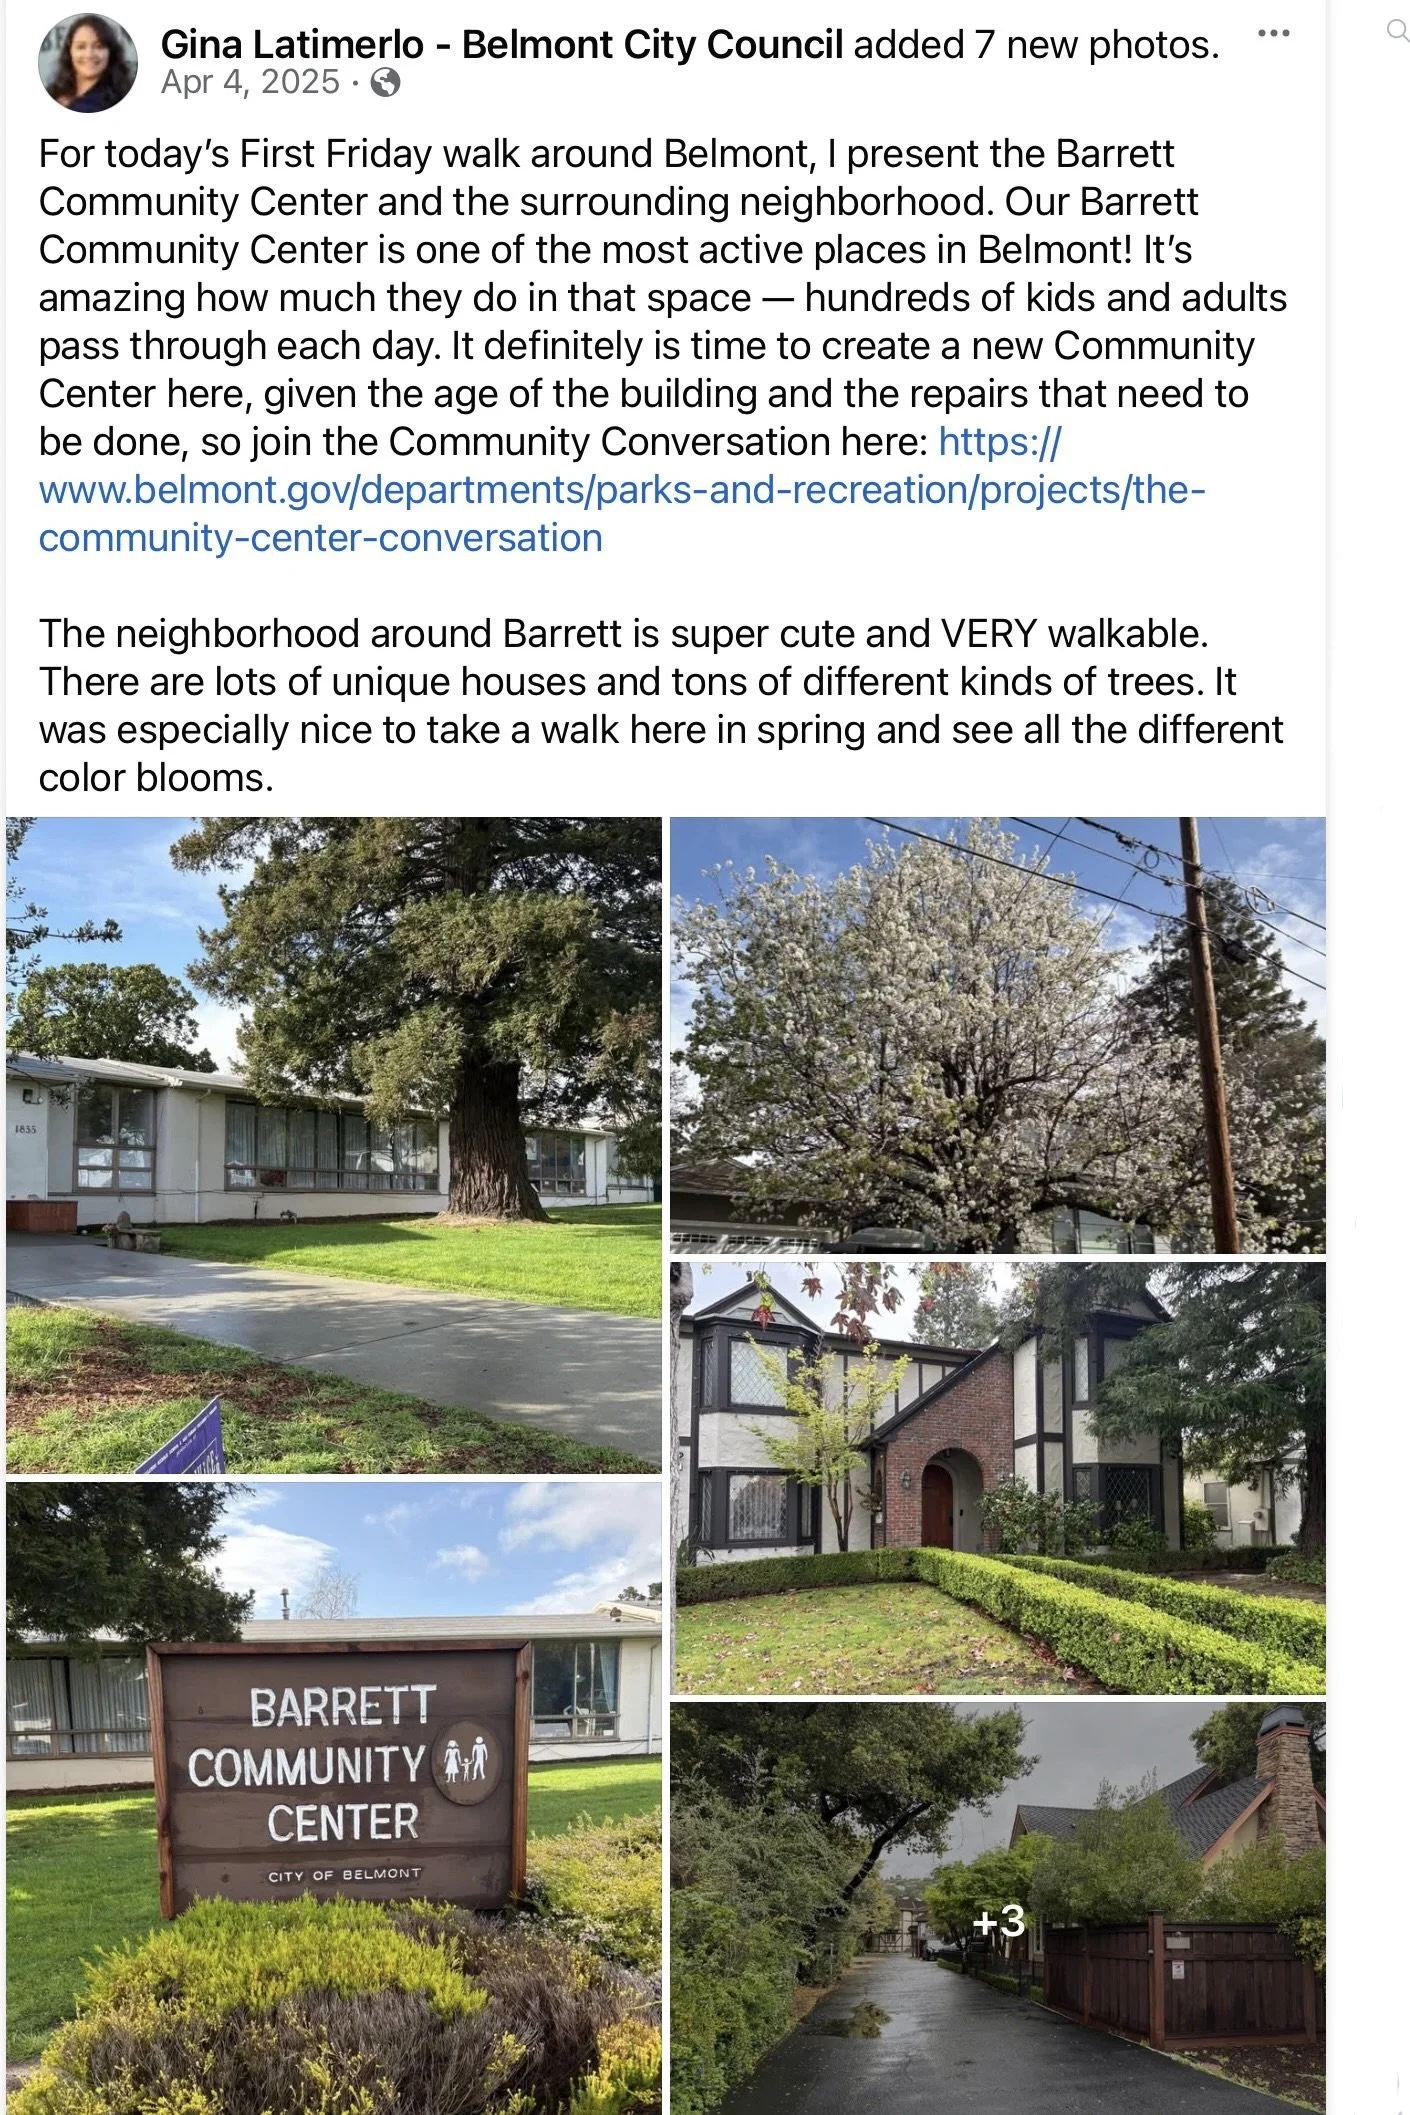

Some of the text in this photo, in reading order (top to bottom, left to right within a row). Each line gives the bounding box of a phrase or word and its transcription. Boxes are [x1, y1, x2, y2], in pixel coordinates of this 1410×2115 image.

[161, 27, 242, 60] Gina
[254, 27, 424, 60] Latimerlo
[463, 27, 614, 60] Belmont
[624, 27, 697, 67] City
[707, 27, 843, 60] Council
[854, 28, 964, 60] added
[975, 29, 996, 59] 7
[1008, 35, 1079, 60] new
[1090, 28, 1219, 66] photos.
[160, 67, 340, 100] Apr 4, 2025
[40, 138, 96, 169] For
[241, 137, 315, 169] First
[327, 137, 433, 175] Friday
[442, 137, 521, 169] walk
[531, 137, 652, 169] around
[665, 137, 817, 175] Belmont,
[829, 138, 835, 168] I
[848, 139, 979, 175] present
[989, 137, 1046, 169] the
[1057, 137, 1175, 169] Barrett
[39, 185, 1199, 224] Community Center and the surrounding neighborhood. Our Barrett
[39, 233, 240, 271] Community
[250, 233, 369, 265] Center
[378, 233, 406, 265] is
[416, 240, 481, 265] one
[491, 232, 526, 265] of
[535, 233, 592, 265] the
[603, 235, 689, 265] most
[699, 233, 804, 265] active
[815, 233, 927, 271] places
[937, 233, 966, 264] in
[979, 233, 1132, 265] Belmont!
[39, 281, 185, 320] amazing
[197, 281, 269, 313] how
[280, 281, 376, 313] much
[386, 281, 463, 319] they
[473, 281, 517, 313] do
[528, 281, 557, 312] in
[567, 281, 636, 313] that
[647, 289, 752, 319] space
[806, 281, 971, 313] hundreds
[981, 280, 1016, 313] of
[1027, 281, 1096, 313] kids
[1107, 281, 1170, 313] and
[1182, 281, 1288, 313] adults
[40, 328, 1256, 368] pass through each day. It definitely is time to create a new Community
[39, 376, 1249, 416] Center here, given the age of the building and the repairs that need to
[40, 425, 1063, 463] be done, so join the Community Conversation here: https://
[38, 473, 1206, 511] www.belmont.gov/departments/parks-and-recreation/projects/the-
[39, 521, 602, 559] community-center-conversation
[38, 617, 1208, 656] The neighborhood around Barrett is super cute and VERY walkable.
[38, 664, 1237, 703] There are lots of unique houses and tons of different kinds of trees. It
[38, 712, 1284, 752] was especially nice to take a walk here in spring and see all the different
[39, 761, 273, 793] color blooms.
[250, 1684, 437, 1728] BARRETT
[188, 1745, 427, 1788] COMMUNITY
[268, 1802, 420, 1843] CENTER
[267, 1867, 423, 1883] CITY OF BELMONT
